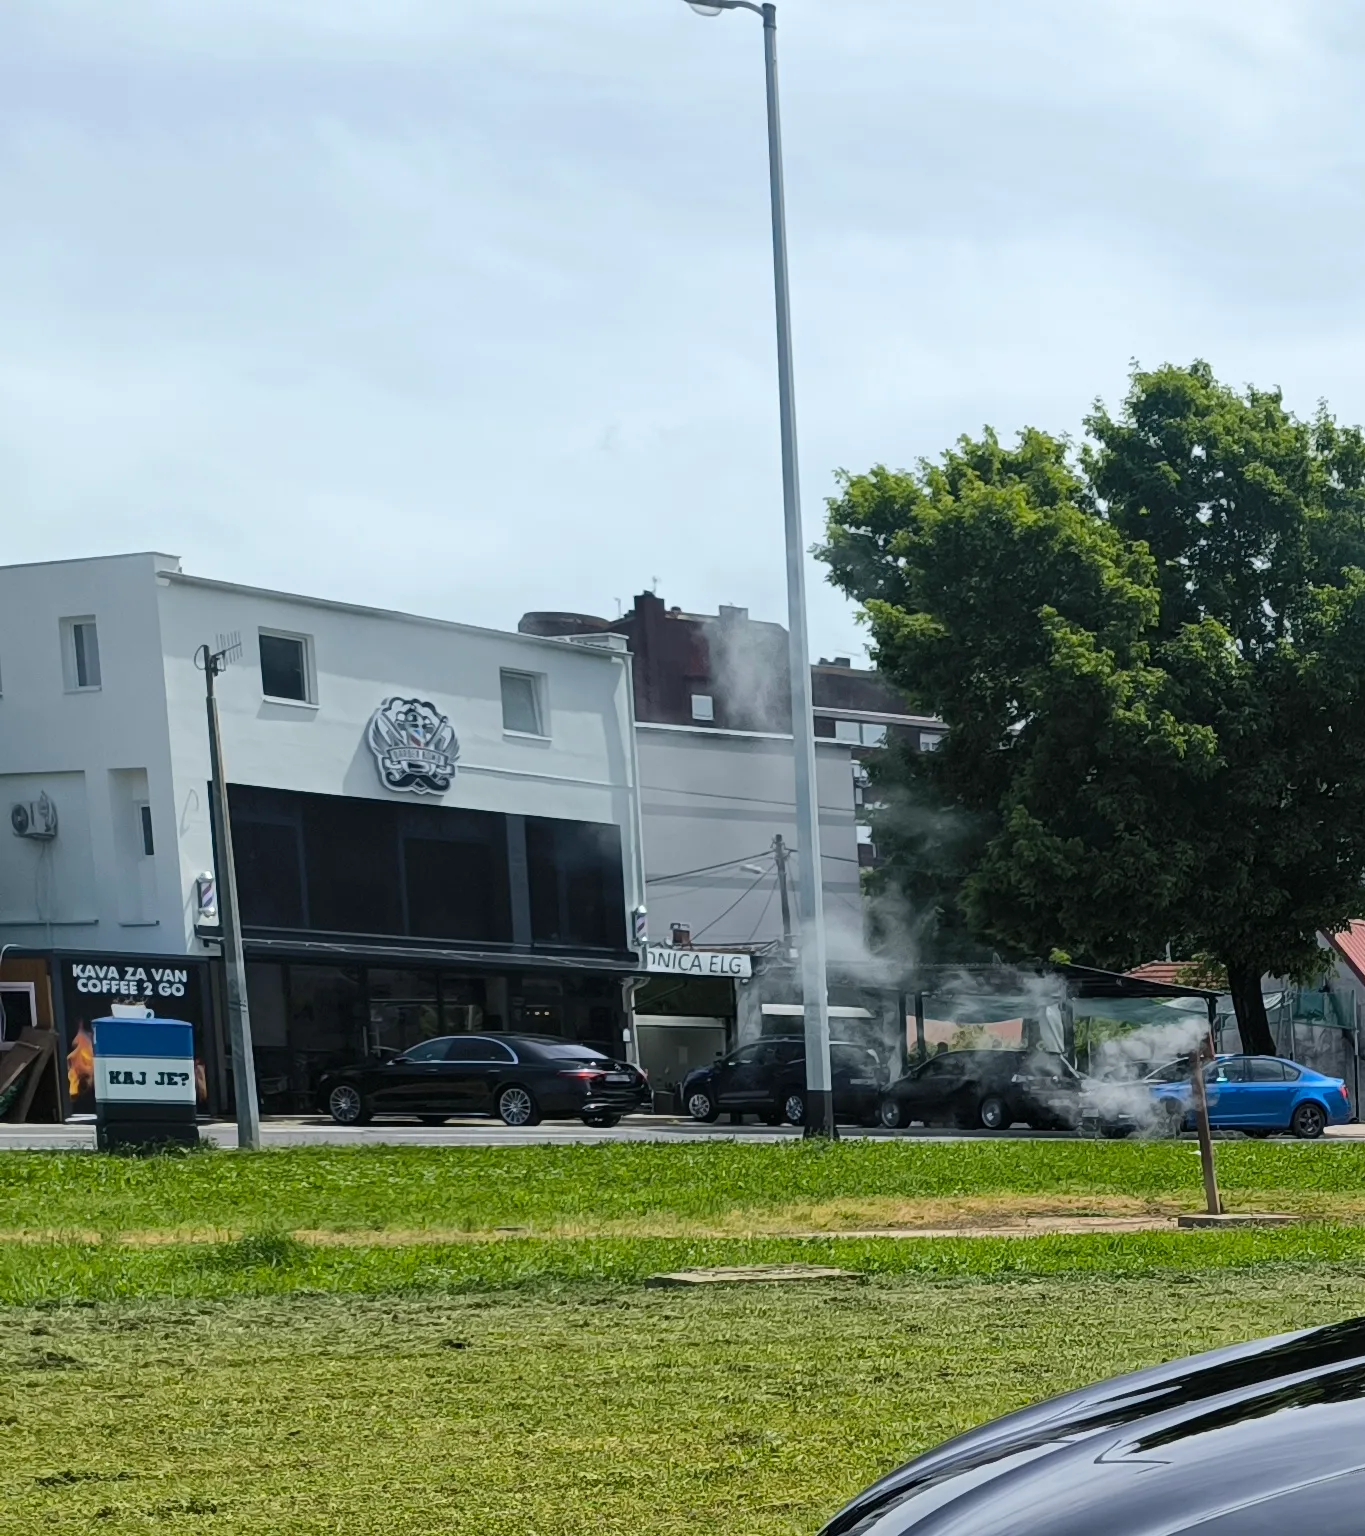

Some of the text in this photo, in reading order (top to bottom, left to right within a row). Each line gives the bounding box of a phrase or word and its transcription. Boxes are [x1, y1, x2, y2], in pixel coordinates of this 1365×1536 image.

[72, 964, 187, 983] KAVA ZA VAN
[709, 955, 742, 974] ELG
[77, 978, 185, 997] COFFEE 2 GO
[154, 1071, 190, 1087] JE?
